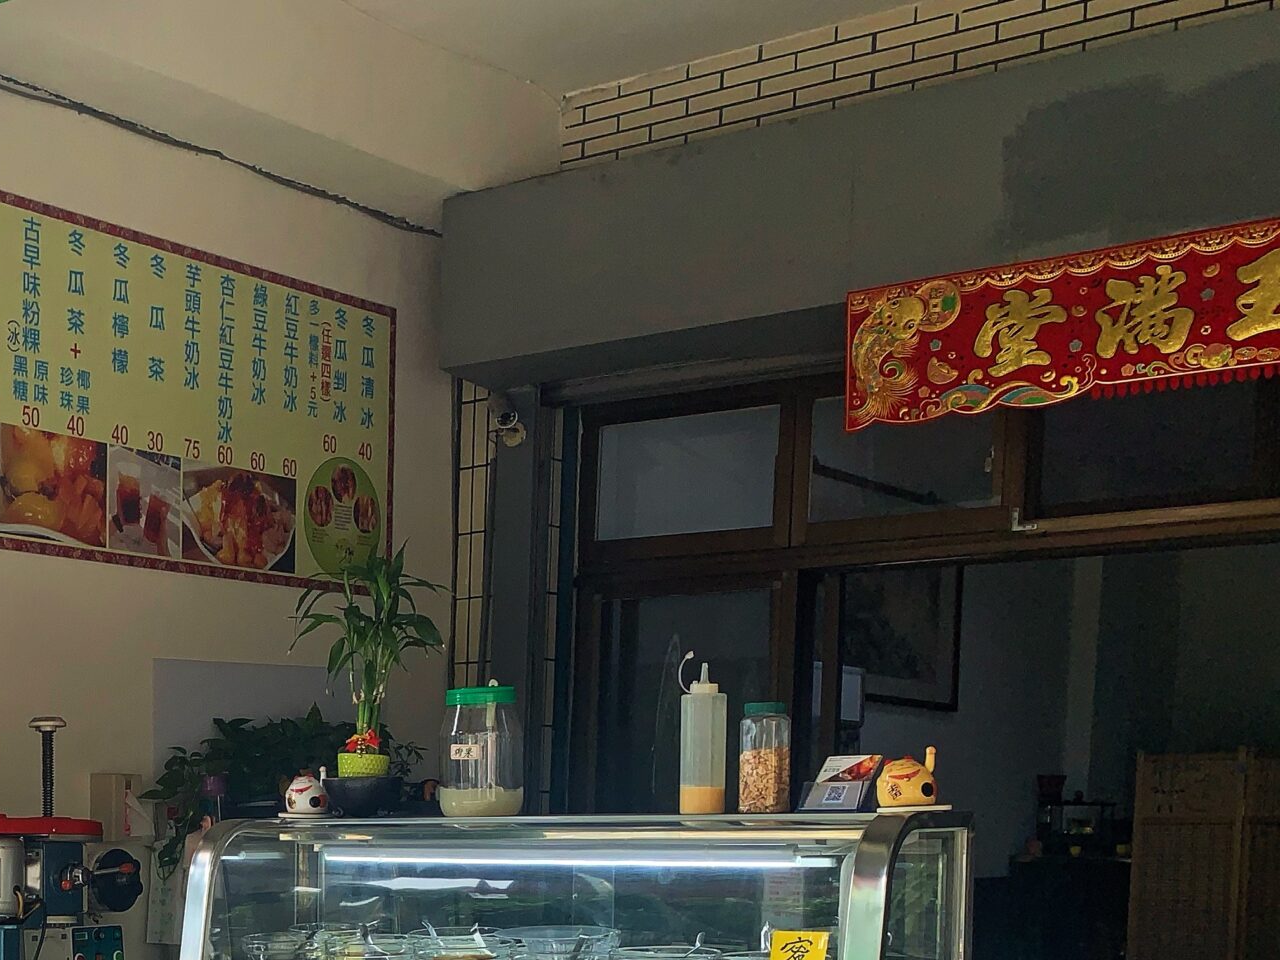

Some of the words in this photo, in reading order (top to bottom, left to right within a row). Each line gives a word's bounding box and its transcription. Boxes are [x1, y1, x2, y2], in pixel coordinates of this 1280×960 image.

[22, 217, 42, 354] 古早味粉粿
[112, 243, 131, 374] 冬瓜檸檬
[148, 254, 166, 382] 冬瓜茶
[183, 263, 202, 390] 芋頭牛奶冰
[217, 274, 235, 443] 杏仁紅豆牛奶冰
[251, 283, 268, 405] 綠豆牛奶冰
[283, 293, 300, 413] 紅豆牛奶冰
[333, 307, 348, 423] 冬瓜剉冰
[13, 355, 29, 402] 黑糖
[33, 360, 49, 405] 原味
[59, 367, 75, 411] 珍珠
[76, 369, 91, 415] 椰果
[360, 315, 376, 429] 冬瓜清冰
[22, 405, 40, 427] 50
[67, 415, 85, 437] 40
[111, 423, 129, 446] 40
[147, 431, 164, 452] 30
[184, 438, 200, 459] 75
[217, 445, 233, 465] 60
[250, 452, 266, 471] 60
[323, 434, 337, 453] 60
[358, 443, 372, 461] 40
[282, 458, 297, 477] 60
